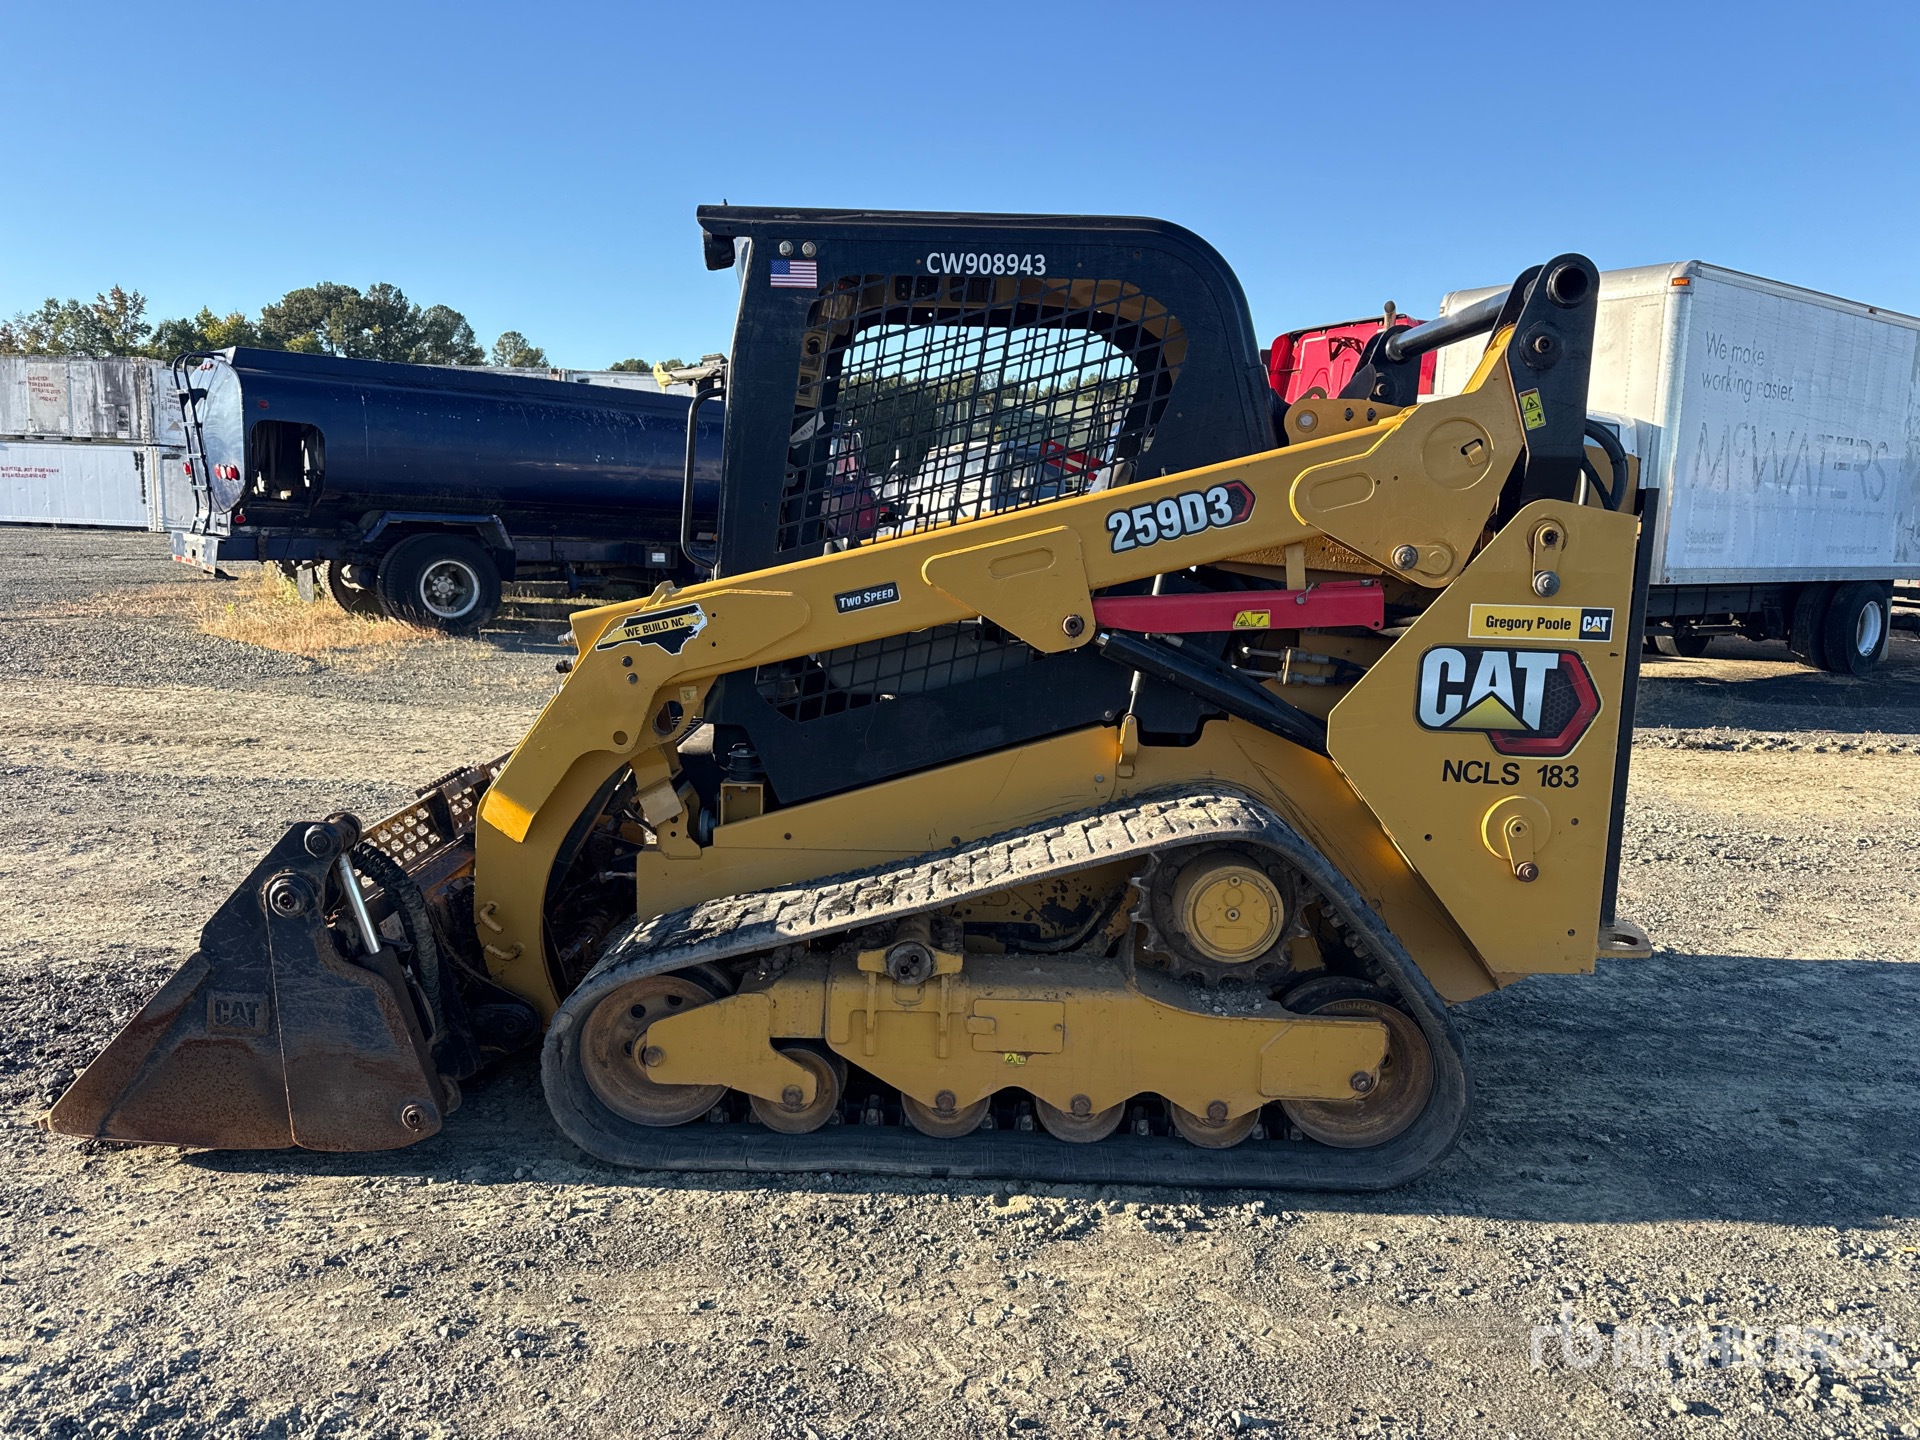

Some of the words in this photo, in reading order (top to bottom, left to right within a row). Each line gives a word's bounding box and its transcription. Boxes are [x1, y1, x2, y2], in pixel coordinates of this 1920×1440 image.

[926, 252, 1047, 276] CW908943
[1705, 331, 1728, 360] We
[1731, 338, 1765, 367] make
[1702, 365, 1753, 404] working
[1756, 377, 1795, 403] easier.
[1107, 486, 1233, 552] 259D3
[624, 626, 641, 638] WE
[642, 620, 669, 634] BUILD
[671, 617, 685, 628] NC
[1485, 615, 1534, 632] Gregory
[1536, 616, 1572, 631] Poole
[1582, 615, 1609, 633] CAT
[1419, 647, 1560, 731] CAT
[1442, 759, 1520, 786] NCLS
[1536, 764, 1580, 788] 183
[215, 999, 260, 1028] CAT
